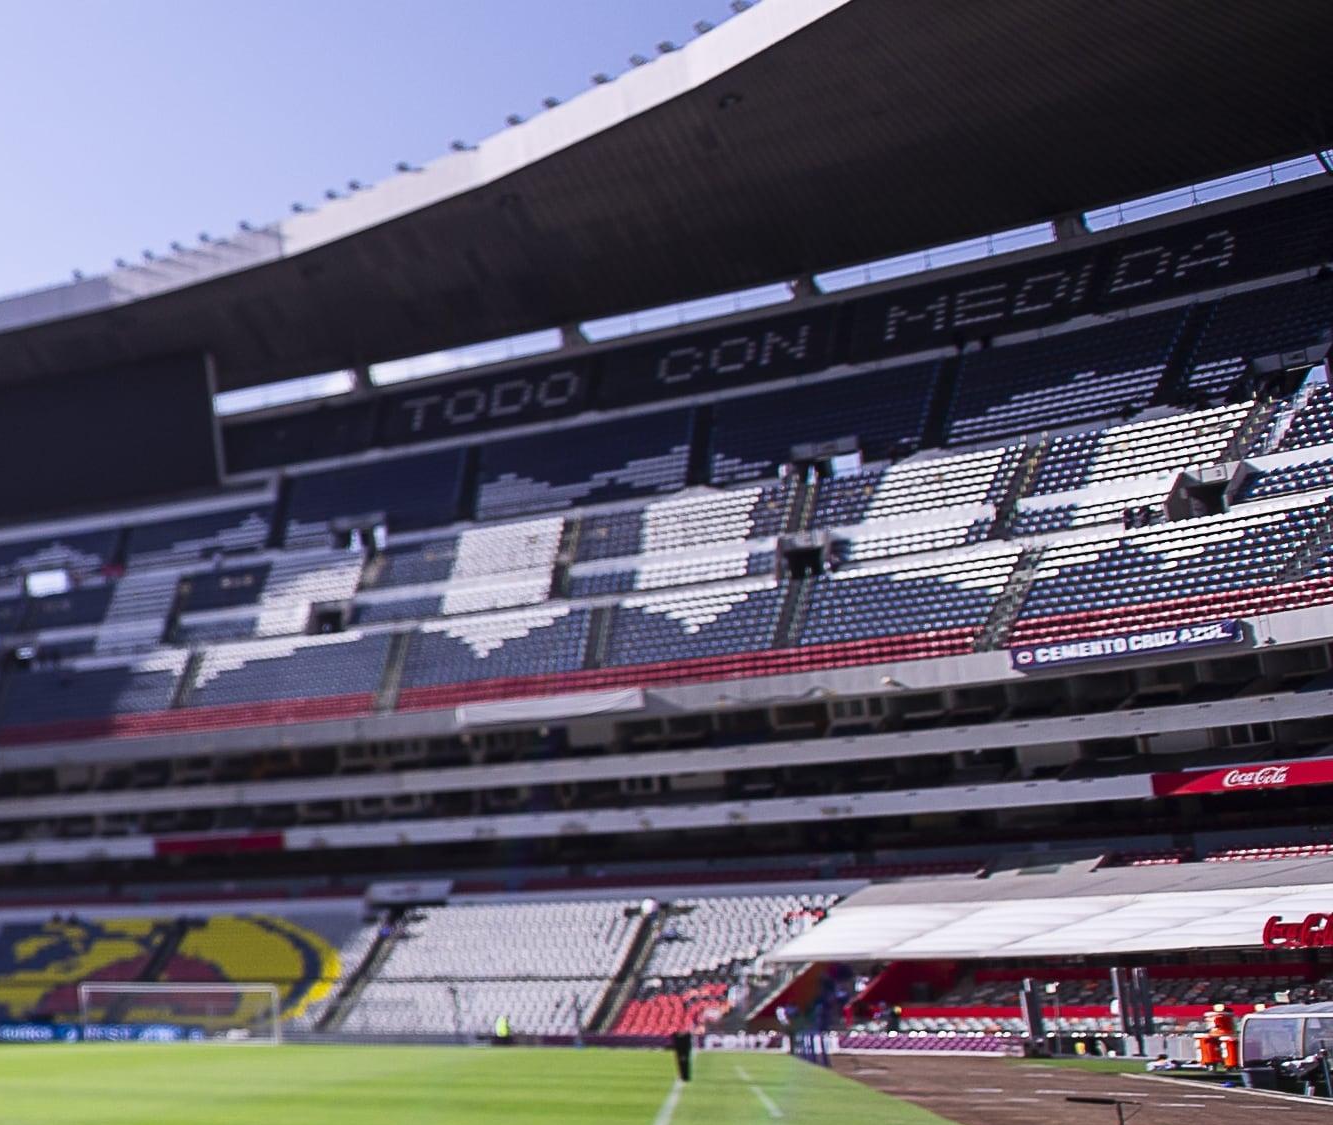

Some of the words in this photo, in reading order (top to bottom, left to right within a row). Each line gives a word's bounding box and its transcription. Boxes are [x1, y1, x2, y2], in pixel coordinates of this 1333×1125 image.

[402, 371, 579, 431] TODO
[657, 325, 810, 384] CON
[884, 230, 1235, 342] MEDIDA
[1035, 638, 1127, 663] CEMENTO
[1128, 632, 1177, 651] CRUZ
[1179, 624, 1232, 643] AZUL
